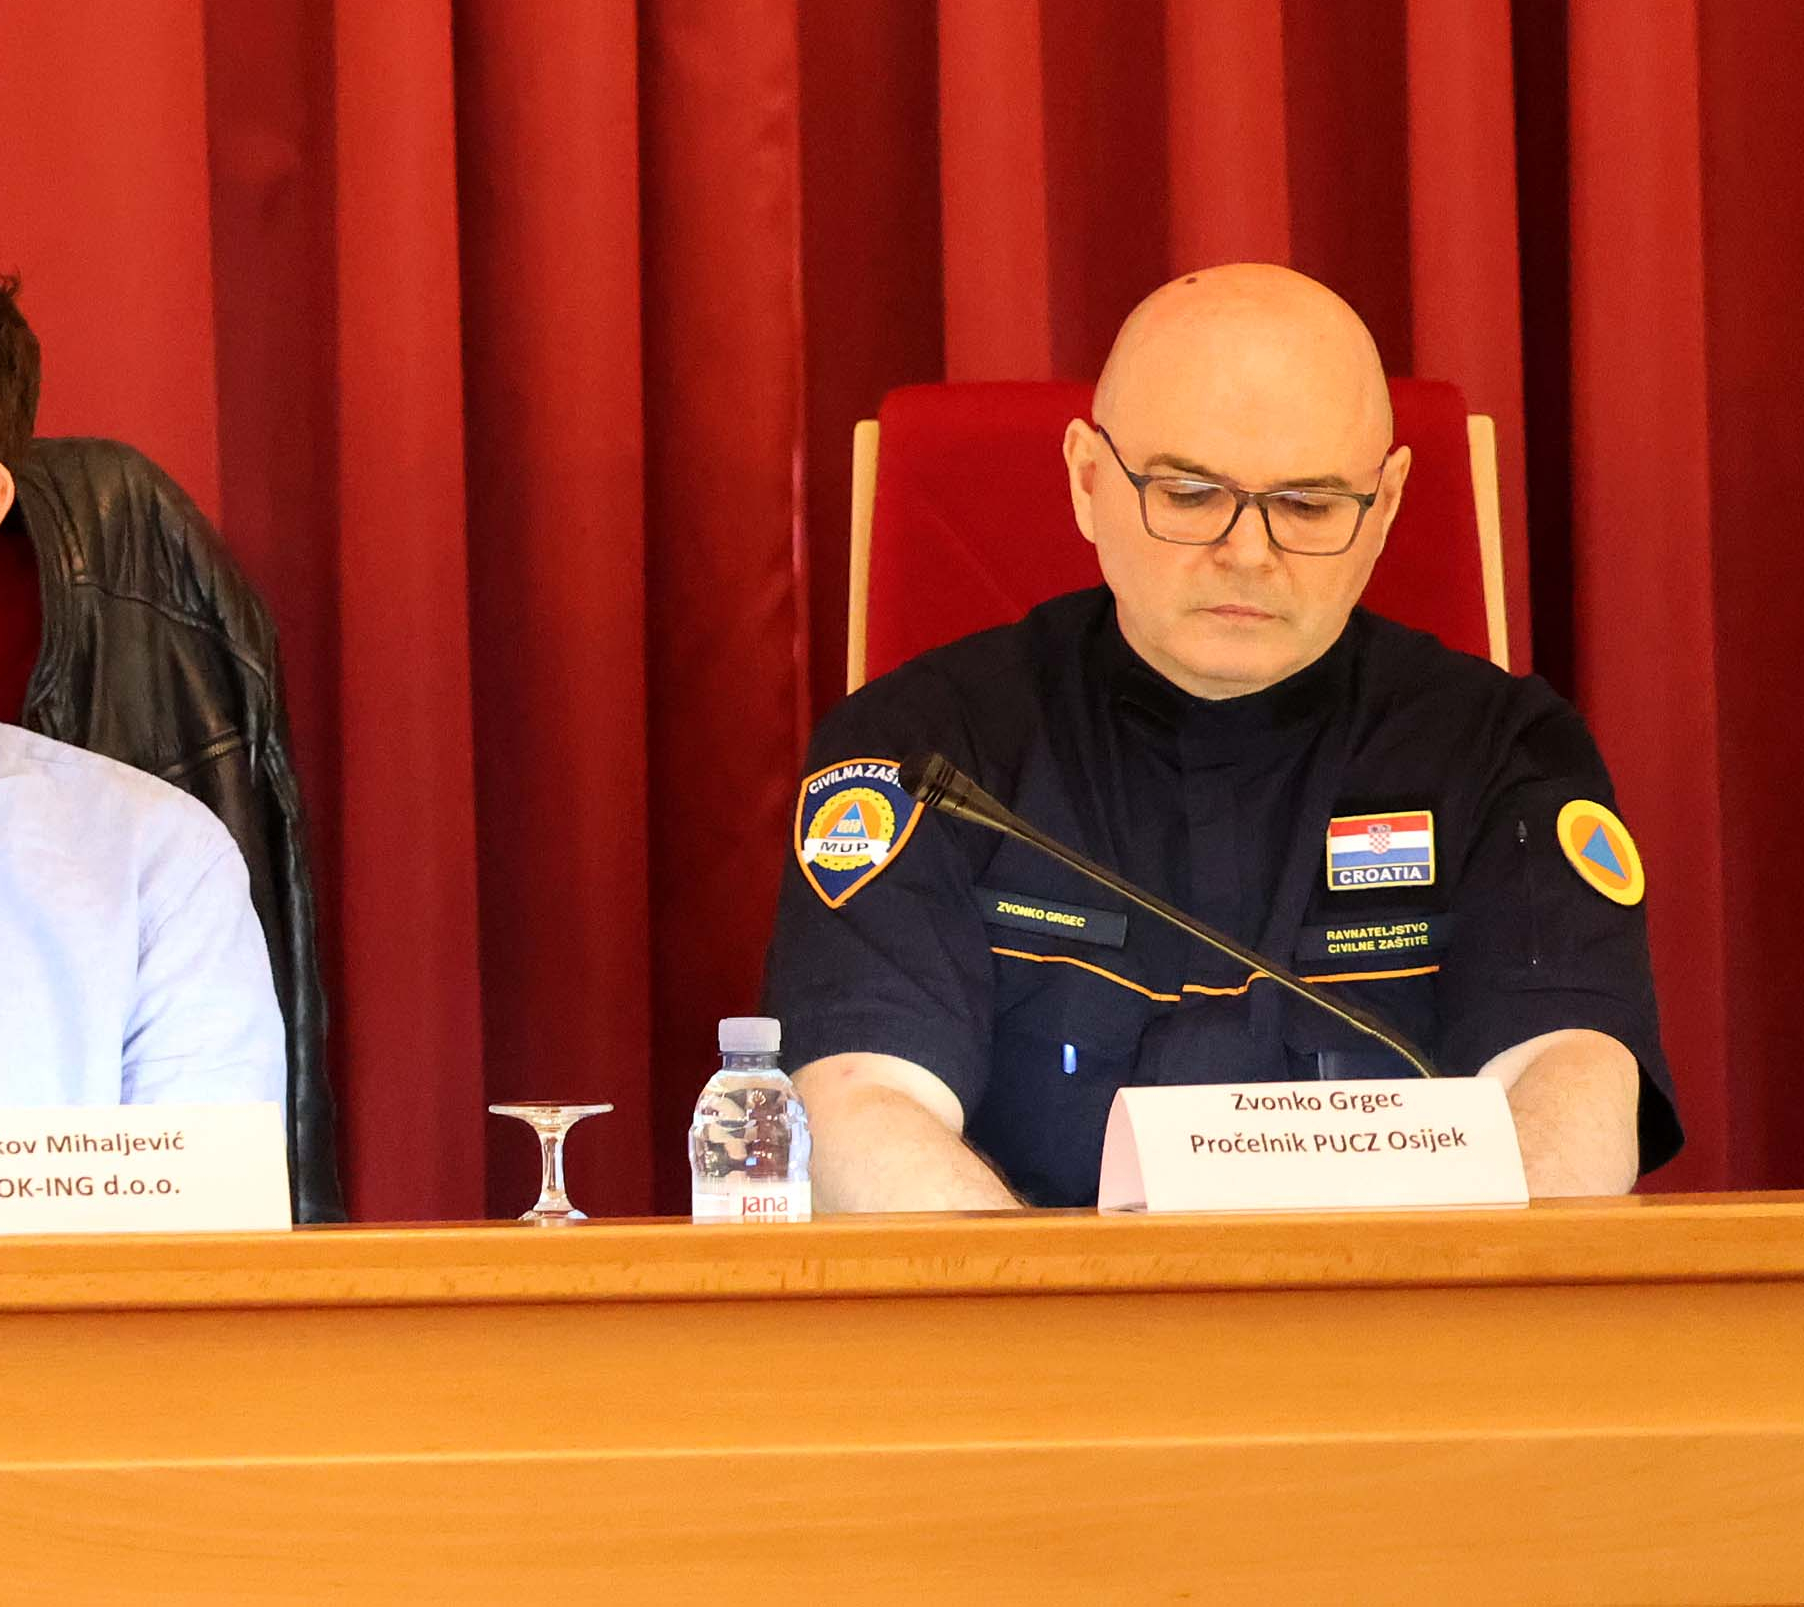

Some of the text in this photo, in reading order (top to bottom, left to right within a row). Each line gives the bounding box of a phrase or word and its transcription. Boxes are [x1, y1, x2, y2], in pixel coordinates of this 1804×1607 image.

[808, 764, 864, 793] CIVILNA
[820, 841, 869, 853] MUP
[1339, 867, 1422, 884] CROATIA
[996, 901, 1086, 927] ZVONKO GRGEC
[1326, 922, 1428, 941] RAVNATELJSTVO
[1328, 935, 1429, 954] CIVILNE ZAŠTITE
[1231, 1091, 1403, 1114] Zvonko Grgec
[47, 1131, 185, 1157] Mihaljević
[1190, 1127, 1468, 1154] Pročelnik PUCZ Osijek
[103, 1174, 180, 1196] d.o.o.
